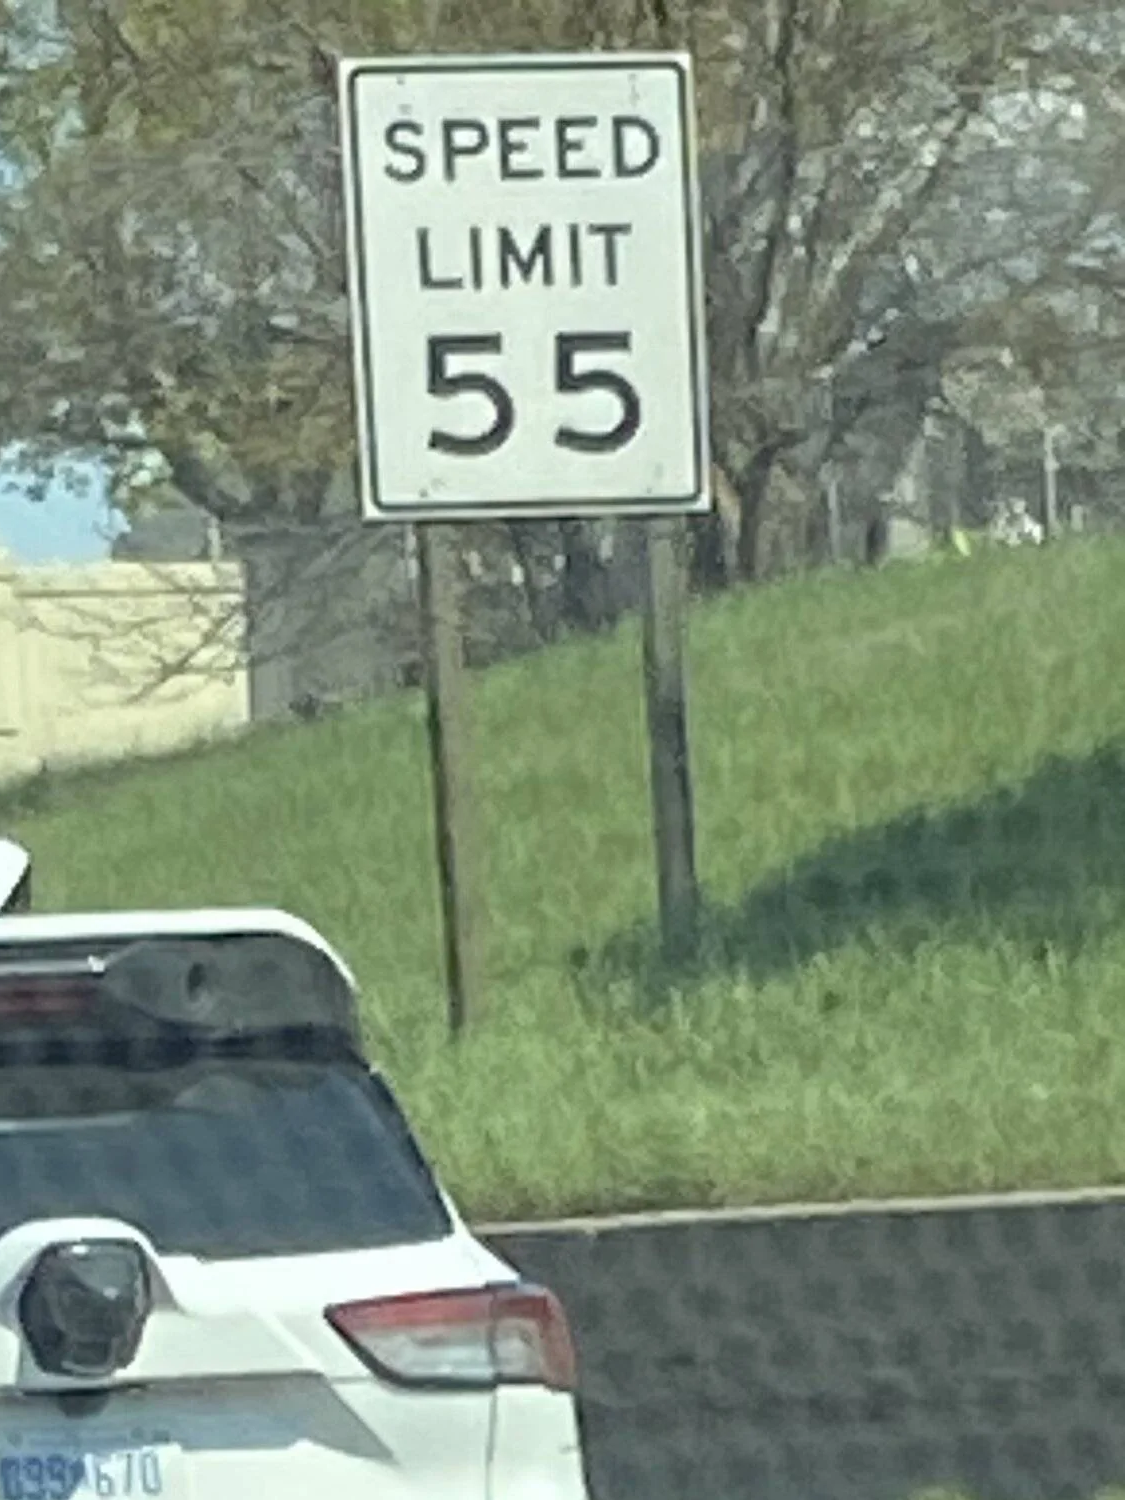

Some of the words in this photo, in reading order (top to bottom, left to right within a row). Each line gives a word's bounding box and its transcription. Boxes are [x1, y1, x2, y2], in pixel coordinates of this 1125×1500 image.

[383, 116, 661, 183] SPEED
[416, 223, 633, 291] LIMIT
[425, 331, 642, 457] 55
